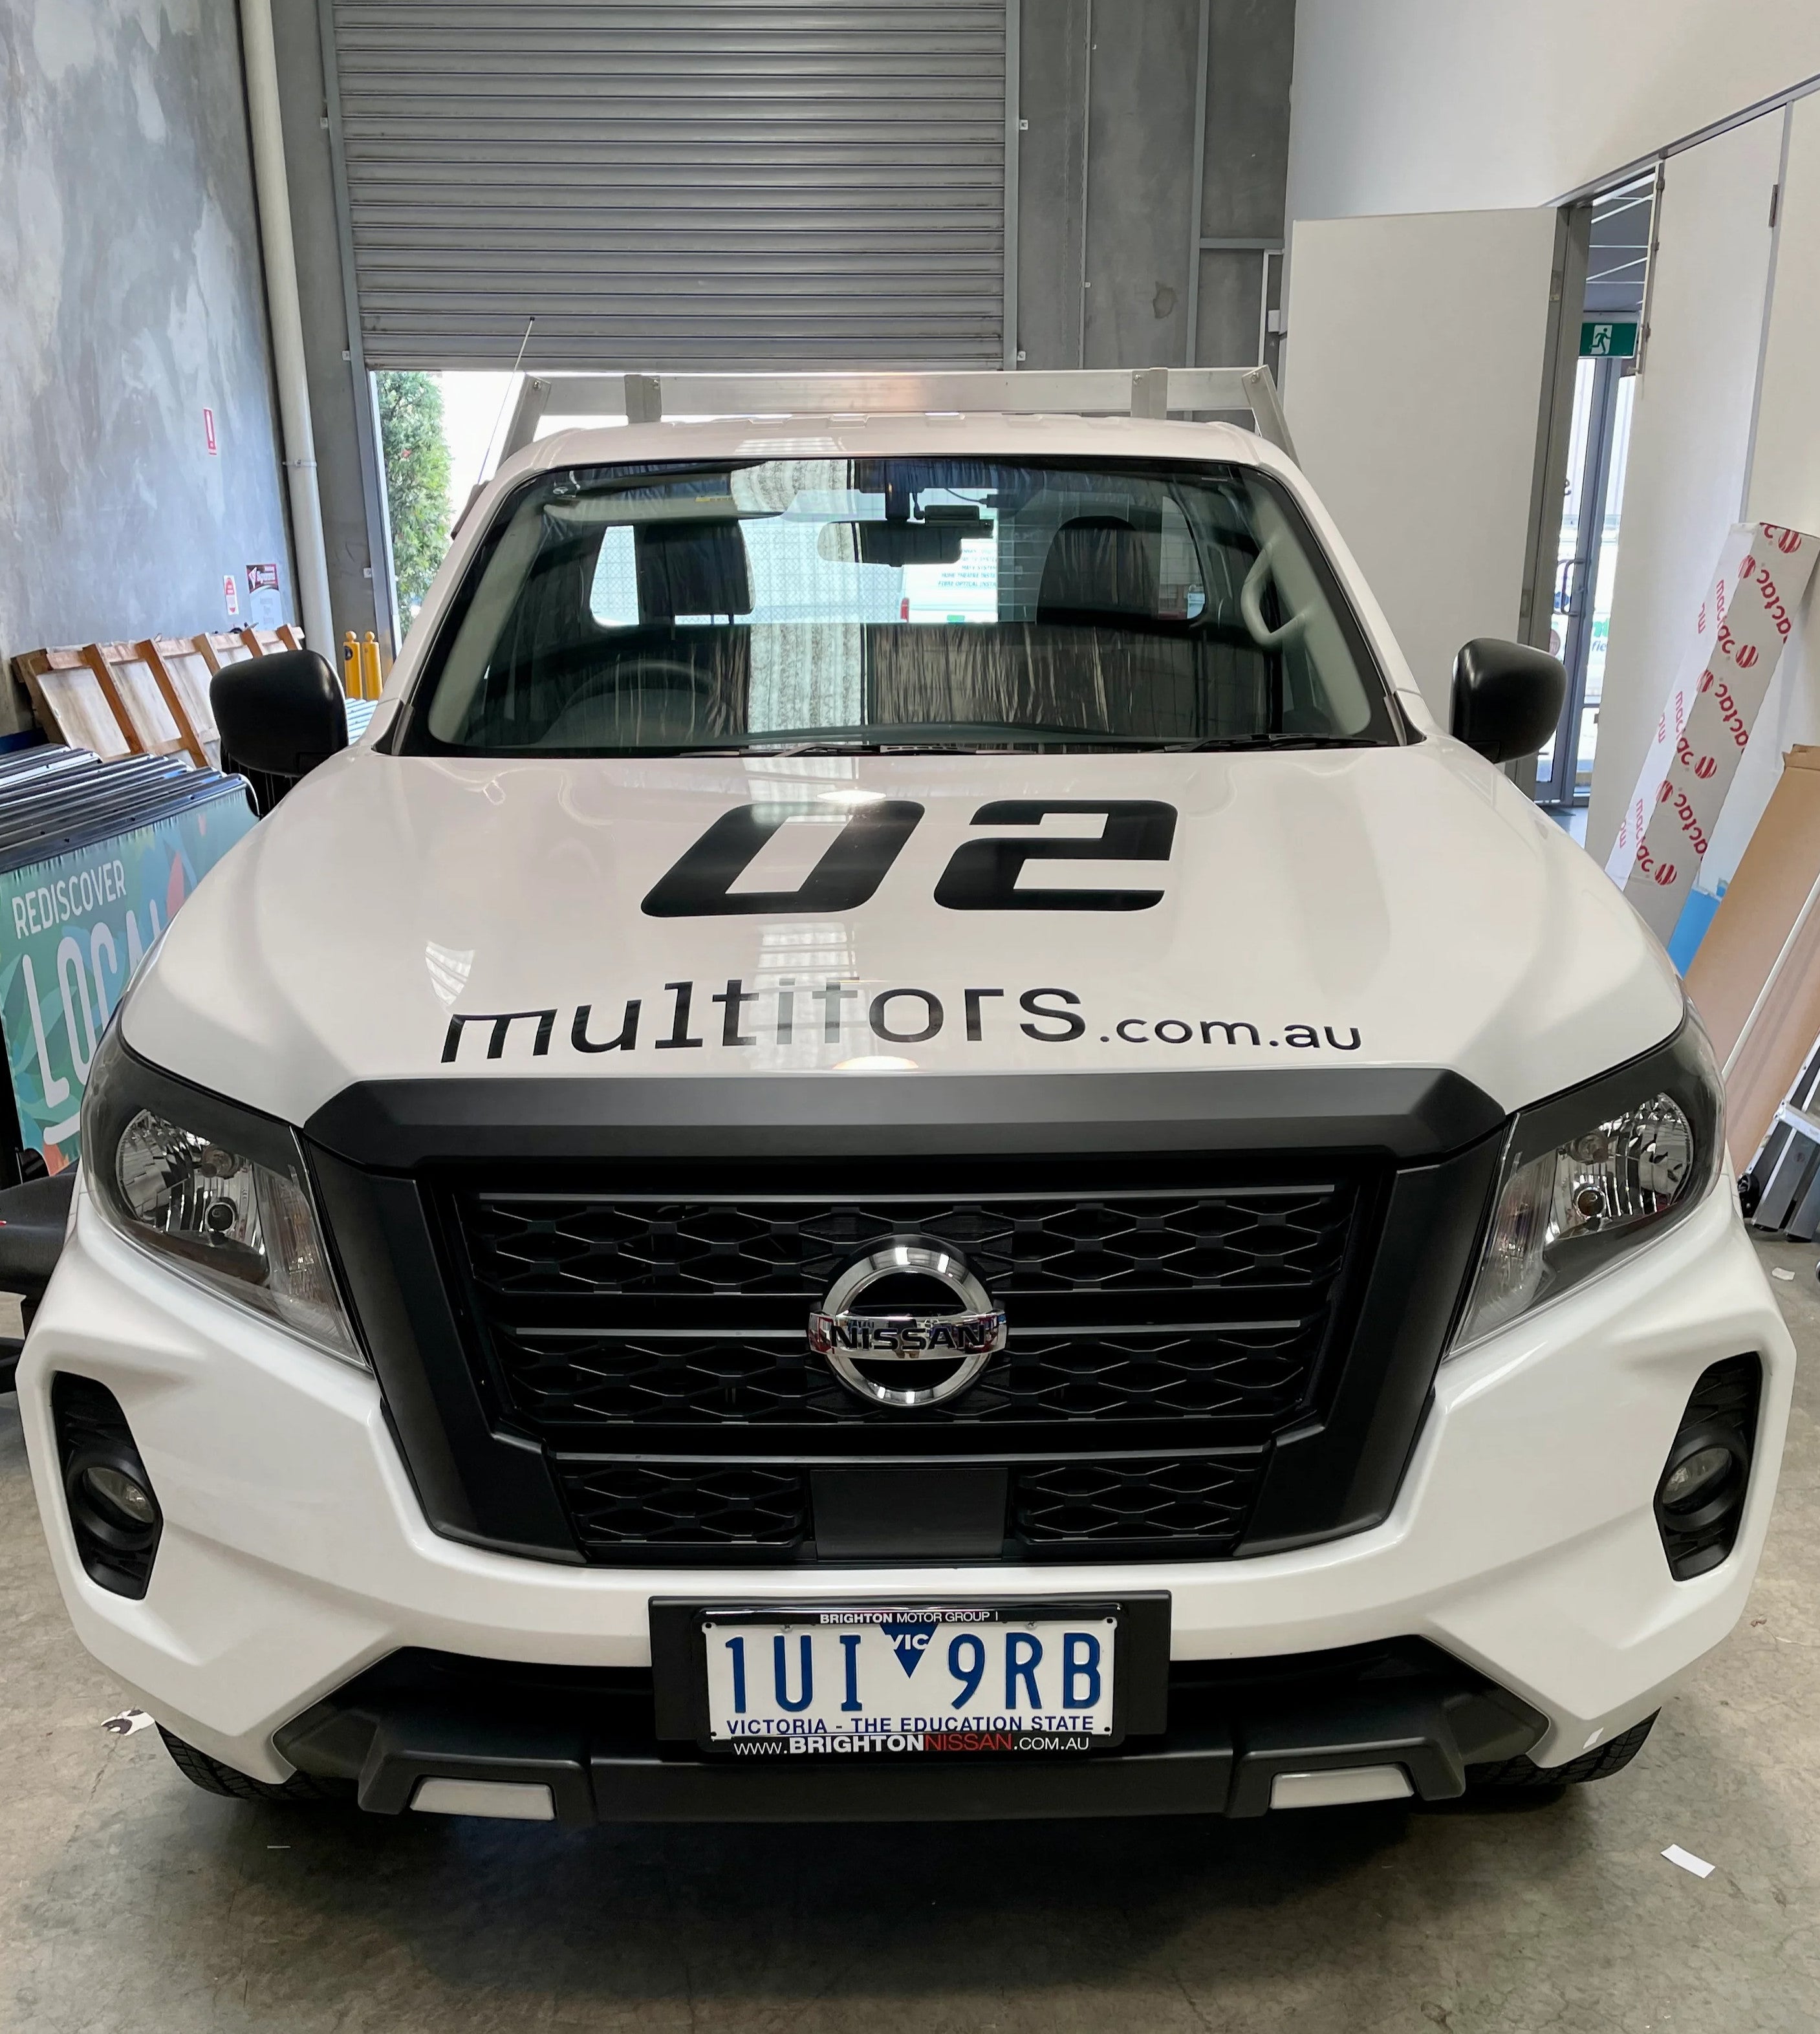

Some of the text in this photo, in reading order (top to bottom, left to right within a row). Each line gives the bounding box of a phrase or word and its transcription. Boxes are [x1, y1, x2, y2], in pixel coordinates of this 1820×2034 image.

[1757, 569, 1791, 644] actac
[1715, 684, 1749, 755] actac
[641, 799, 1178, 918] 02
[1674, 794, 1707, 861] actac
[12, 860, 127, 940] REDISCOVER
[830, 1325, 987, 1351] NISSAN
[820, 1613, 893, 1624] BRIGHTON
[896, 1612, 942, 1623] MOTOR
[945, 1612, 990, 1622] GROUP
[885, 1634, 930, 1650] VIC
[947, 1632, 1102, 1711] 9RB
[726, 1718, 828, 1735] VICTORIA
[850, 1717, 892, 1733] THE
[900, 1716, 1022, 1732] EDUCATION
[1031, 1716, 1094, 1731] STATE
